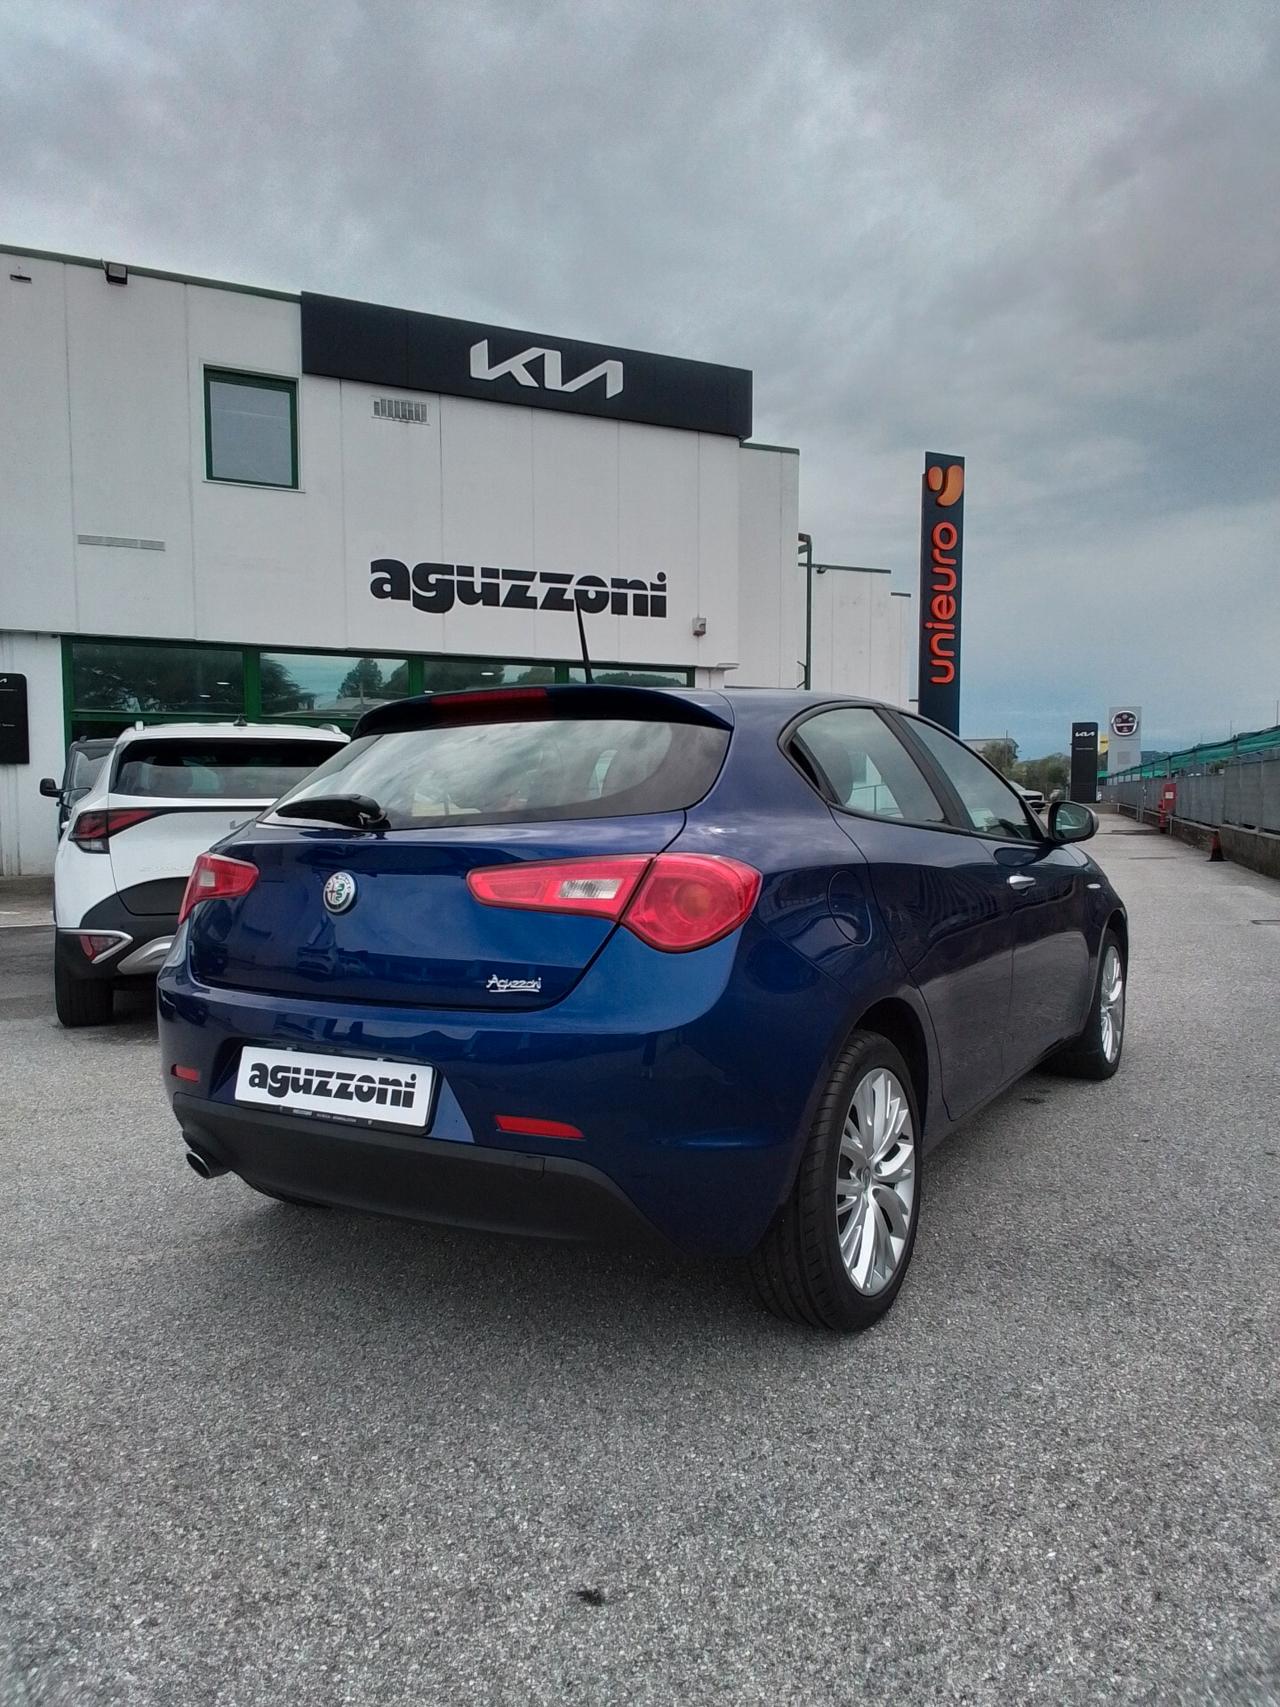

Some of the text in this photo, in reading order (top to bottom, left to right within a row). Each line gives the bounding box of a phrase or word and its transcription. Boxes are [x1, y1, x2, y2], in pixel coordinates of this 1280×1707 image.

[470, 339, 623, 399] KIA
[370, 558, 667, 619] aguzzoni
[925, 521, 958, 684] unieuro
[248, 1062, 417, 1109] aguzzoni
